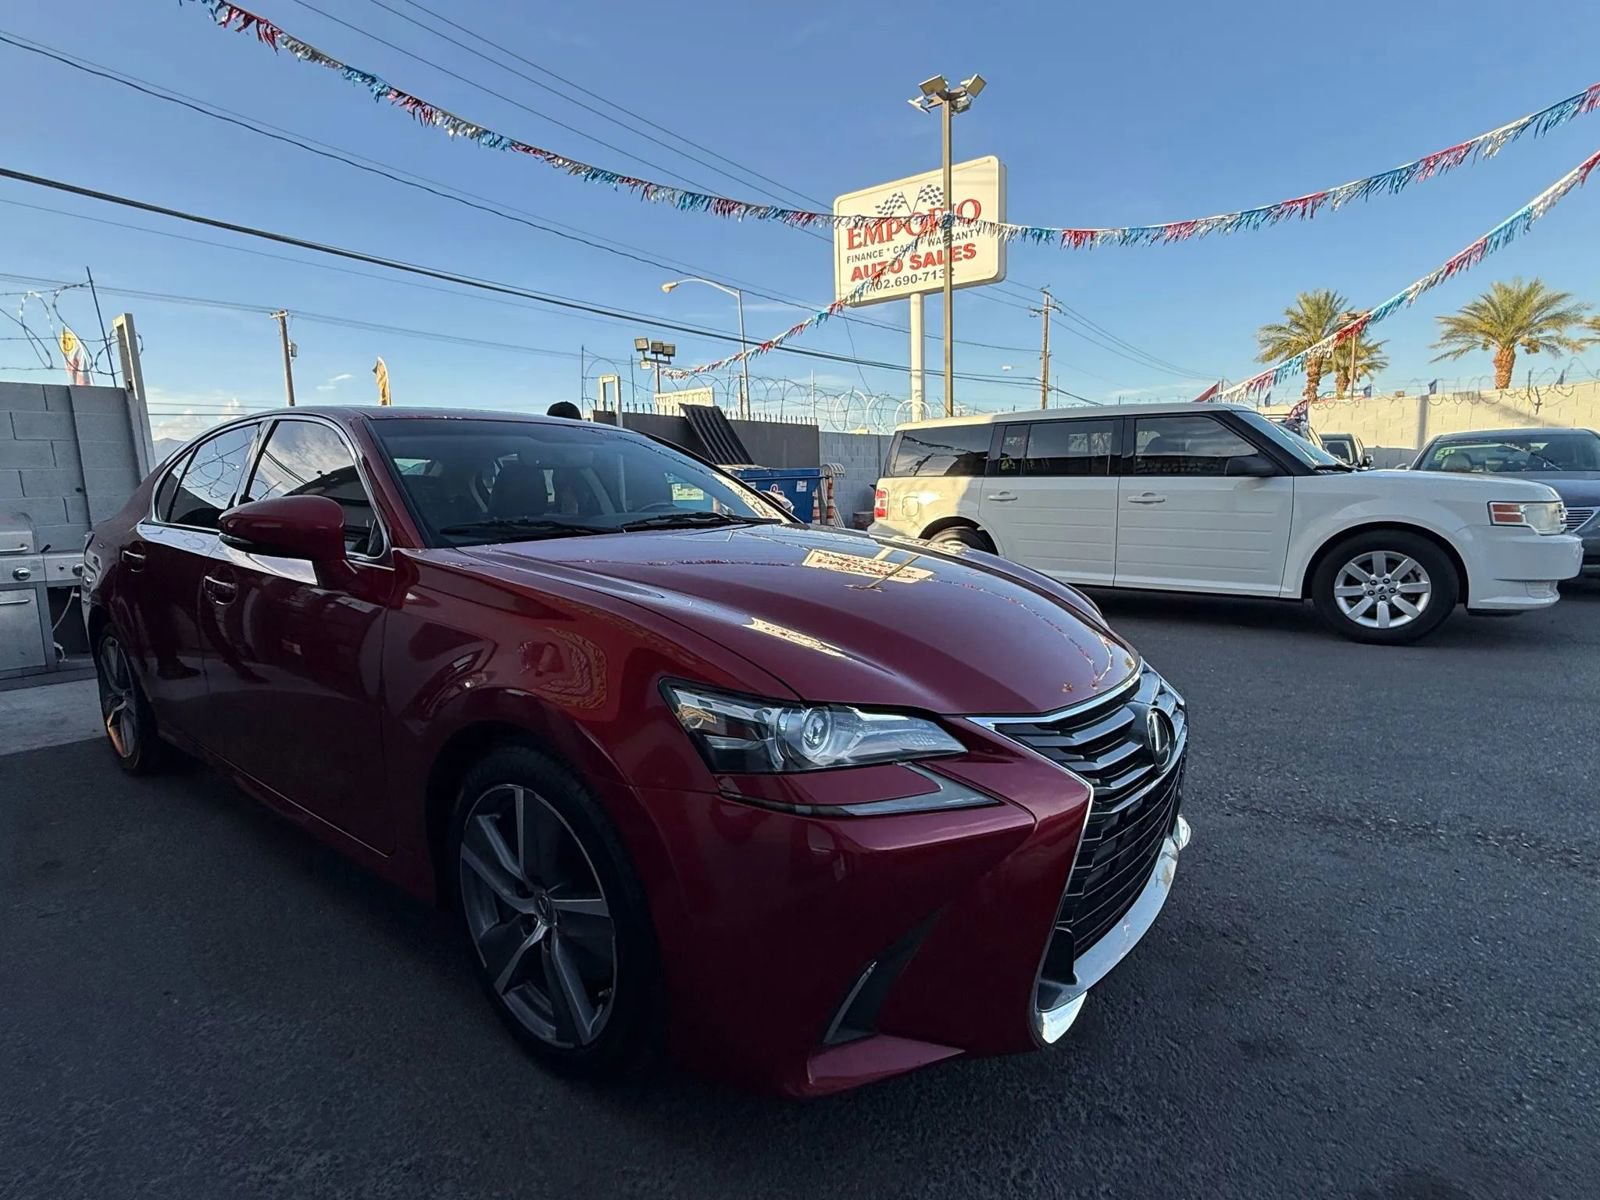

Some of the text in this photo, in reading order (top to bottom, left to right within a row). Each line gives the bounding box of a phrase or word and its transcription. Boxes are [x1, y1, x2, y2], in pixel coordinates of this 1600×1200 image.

[847, 199, 981, 250] EMPORO
[846, 249, 884, 264] FINANCE
[927, 228, 981, 247] WAANTY
[909, 243, 977, 270] SALES
[866, 267, 955, 293] 02.690-713
